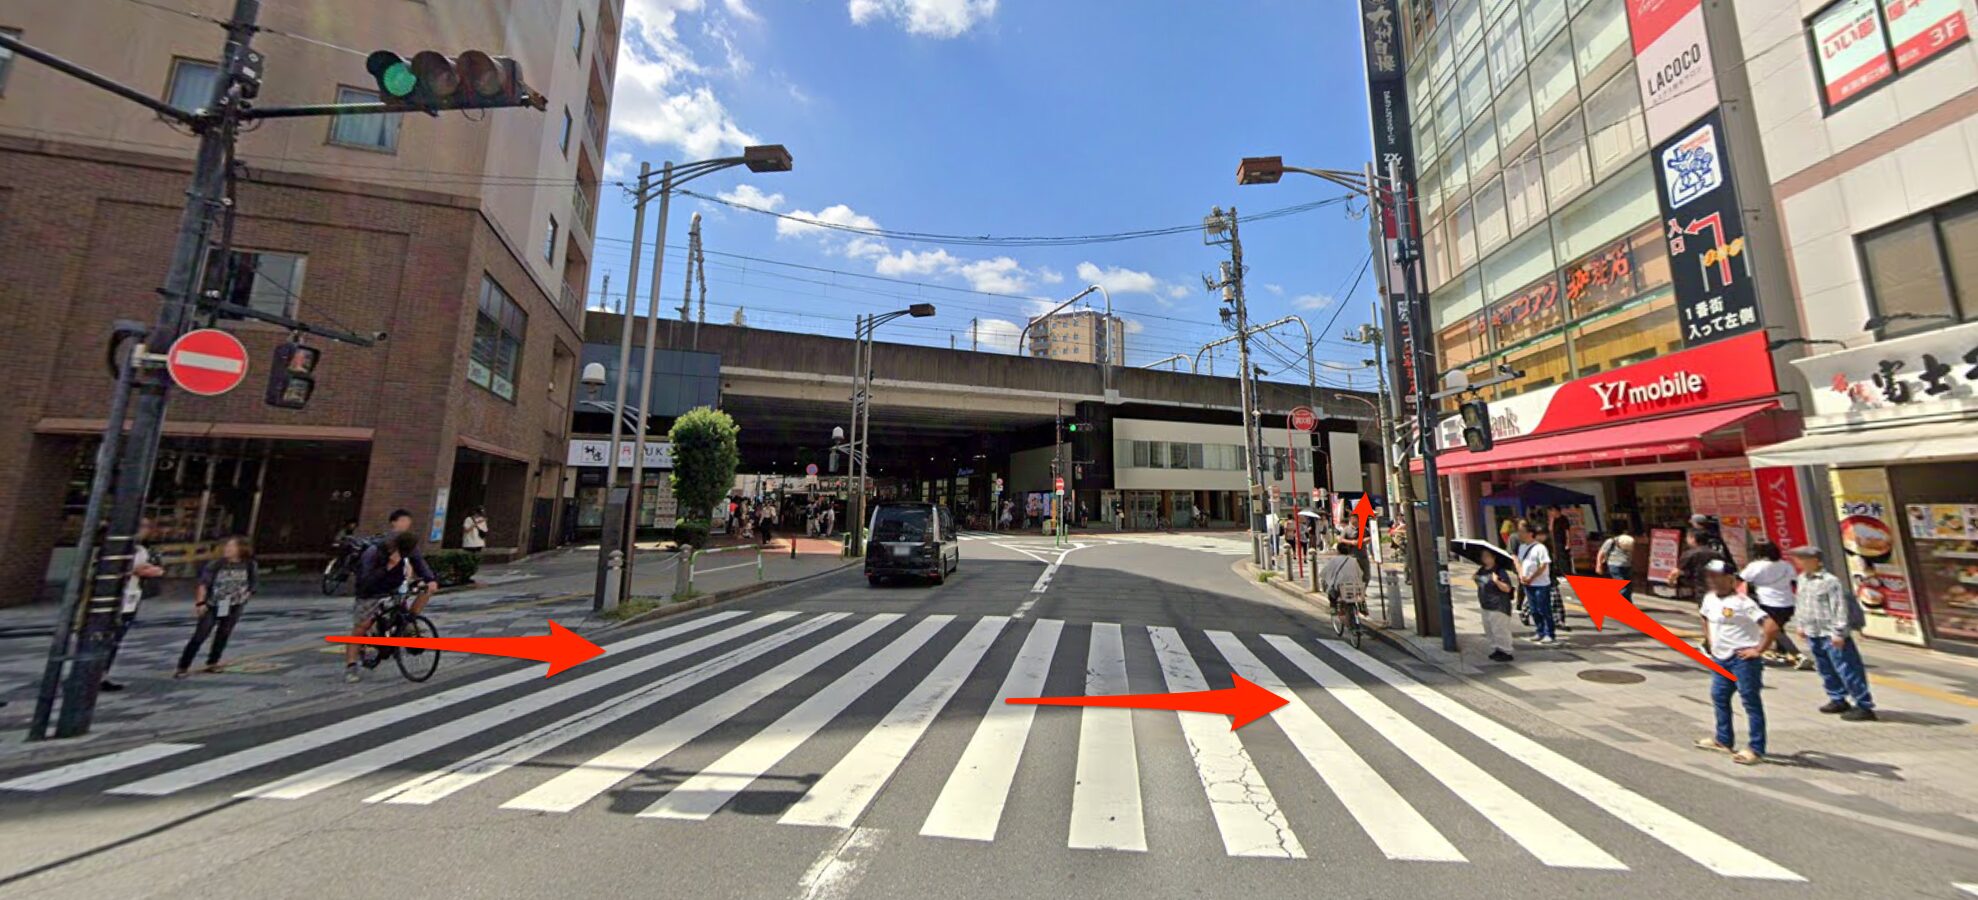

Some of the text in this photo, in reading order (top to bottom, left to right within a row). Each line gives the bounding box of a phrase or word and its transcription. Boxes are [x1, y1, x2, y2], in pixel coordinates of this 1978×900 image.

[1928, 17, 1960, 47] 3F
[1647, 43, 1702, 96] LACOCO
[1667, 218, 1686, 257] 入口
[1685, 295, 1725, 320] 1番街
[1688, 306, 1756, 340] 入って左側
[1589, 369, 1704, 412] Y!mobile
